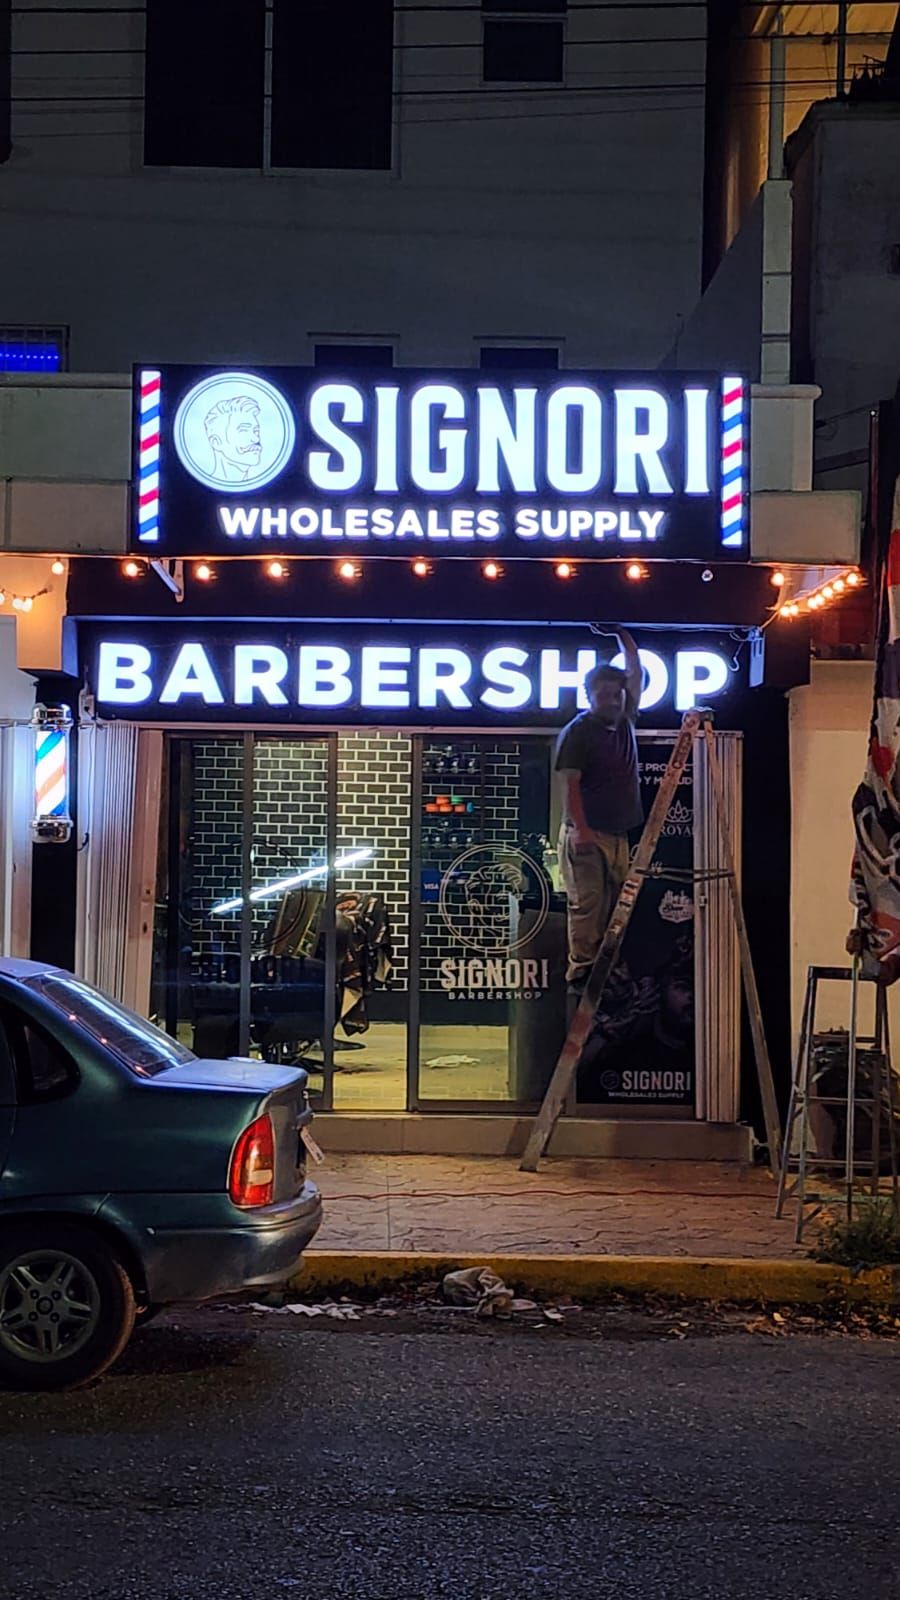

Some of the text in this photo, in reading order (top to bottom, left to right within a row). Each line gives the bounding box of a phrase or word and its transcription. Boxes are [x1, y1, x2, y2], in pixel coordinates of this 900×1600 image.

[307, 383, 711, 496] SIGNORI
[219, 507, 666, 541] WHOLESALES SUPPLY
[97, 641, 729, 712] BARBERSHOP
[660, 825, 694, 836] ROYA
[441, 959, 549, 988] SIGNORI
[622, 1070, 691, 1090] SIGNORI
